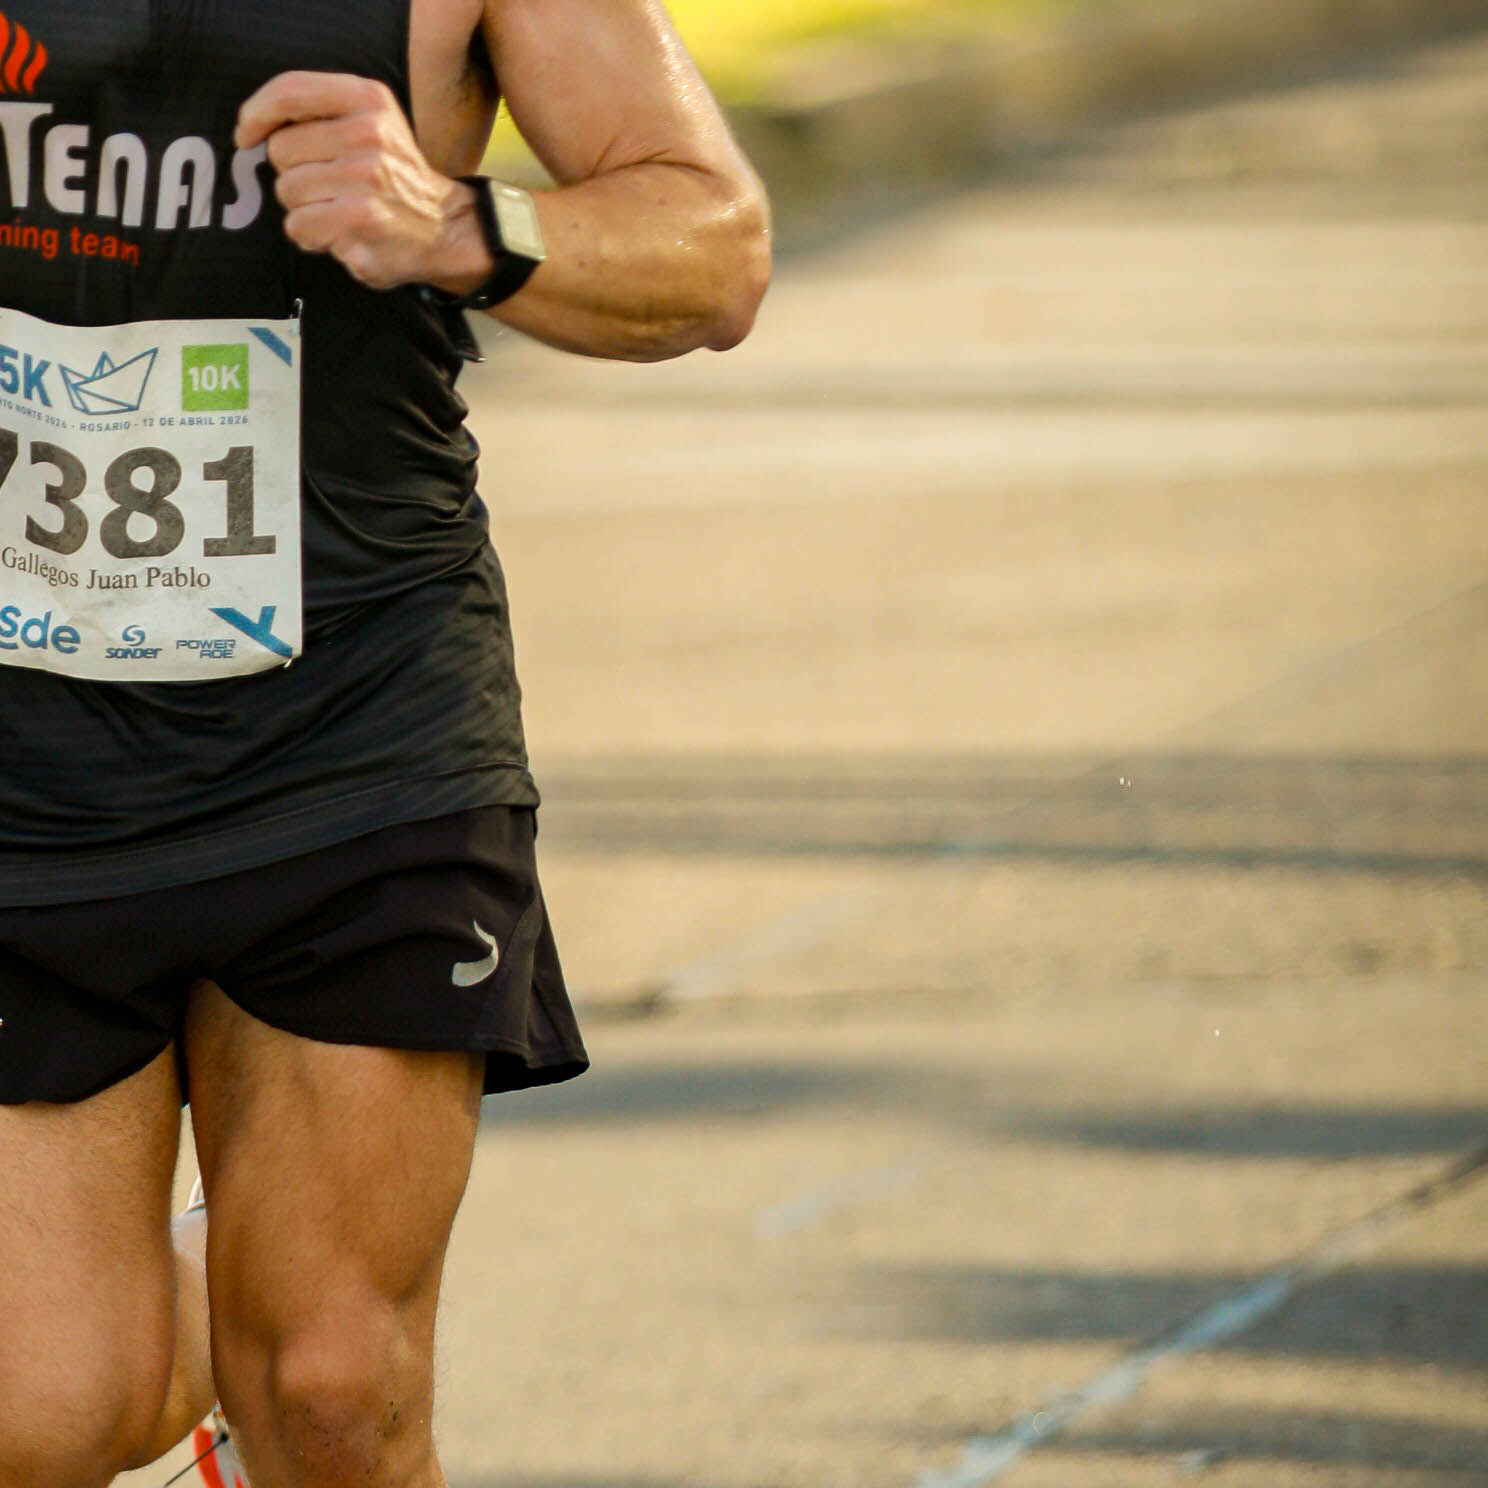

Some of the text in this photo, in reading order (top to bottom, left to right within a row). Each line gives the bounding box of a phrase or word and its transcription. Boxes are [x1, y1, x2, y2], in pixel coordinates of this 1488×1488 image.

[188, 364, 241, 392] 10K
[79, 421, 131, 433] ROSARIO
[159, 416, 176, 427] DE
[179, 415, 216, 427] ABRIL
[1, 546, 212, 590] Gallegos Juan Pablo
[175, 639, 237, 650] POWER
